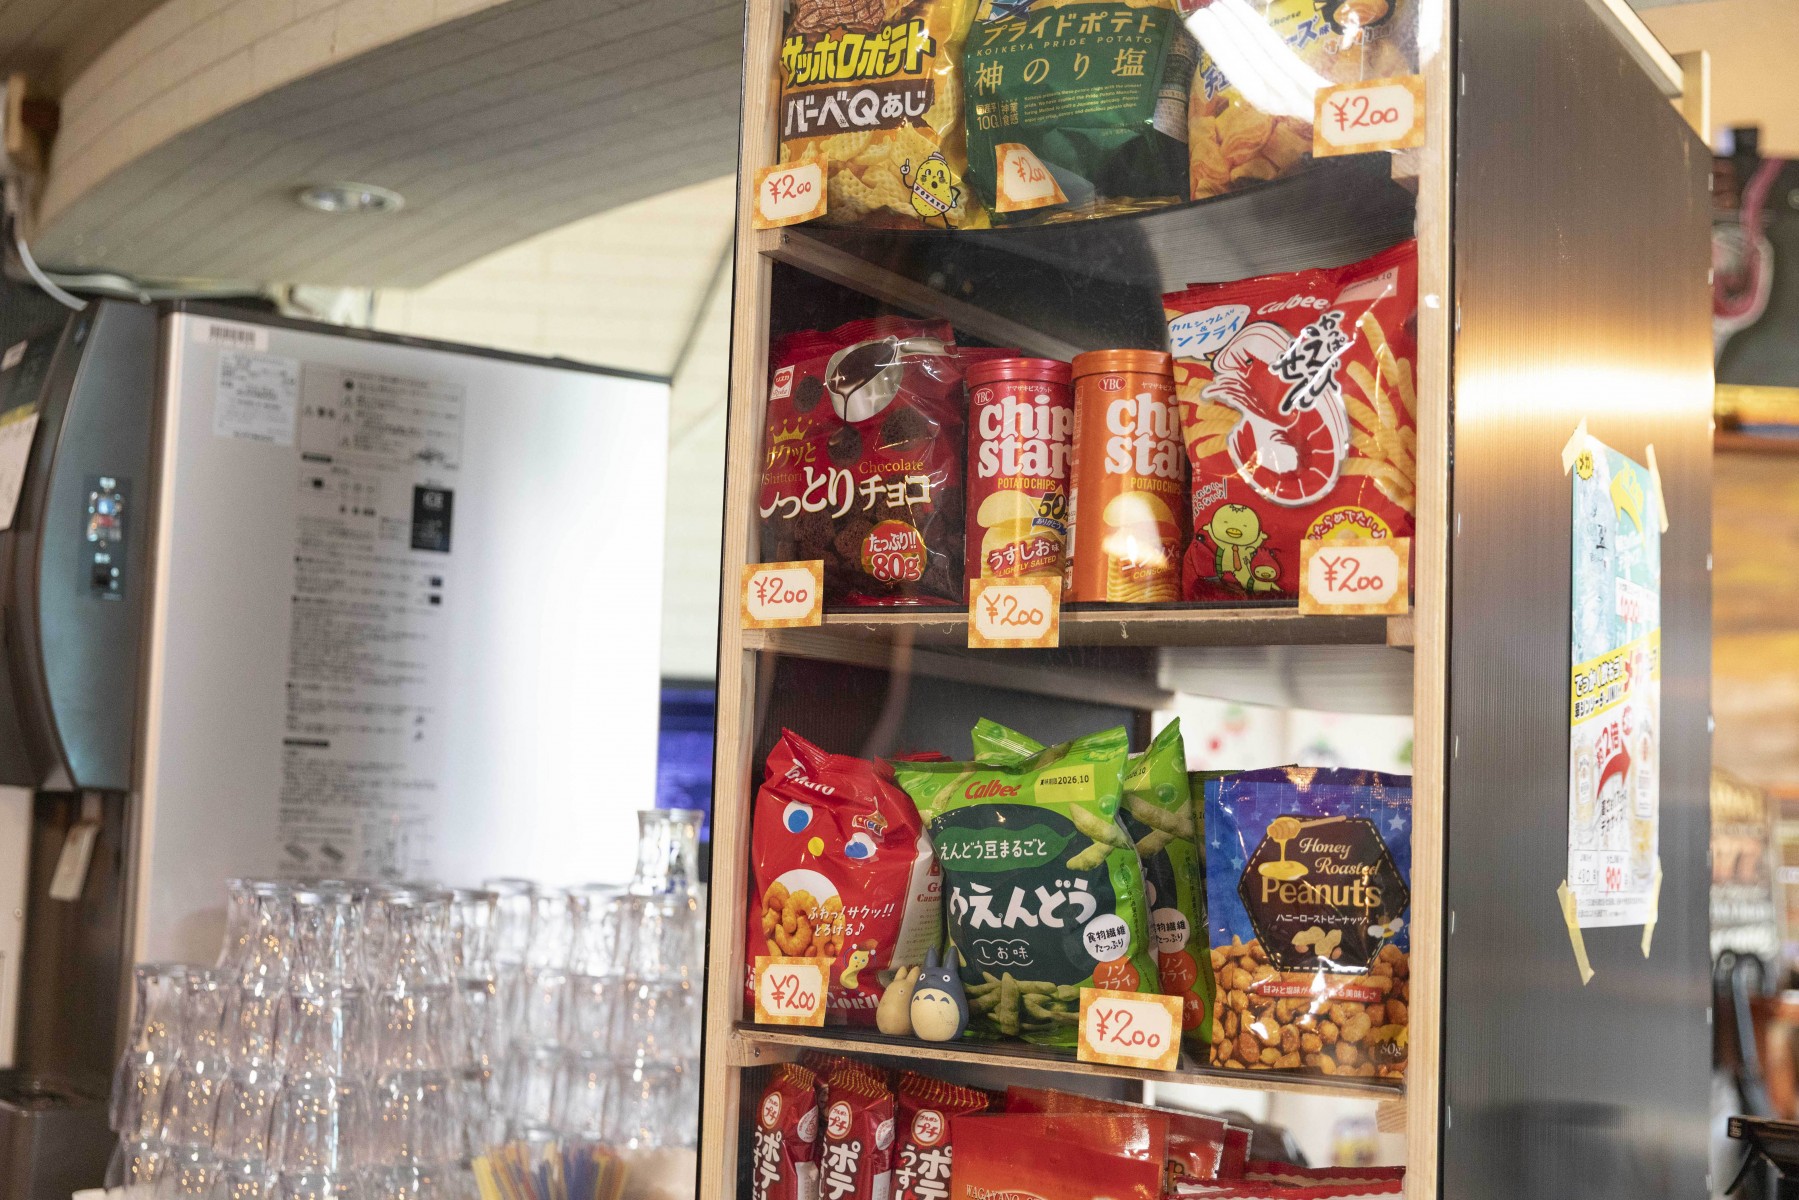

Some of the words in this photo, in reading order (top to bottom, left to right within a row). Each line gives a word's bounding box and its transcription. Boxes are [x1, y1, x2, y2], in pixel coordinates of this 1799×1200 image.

[983, 11, 1156, 46] プライドポテト
[782, 18, 935, 88] サッポロポテト
[977, 43, 1034, 57] KOIKEYA
[1044, 38, 1086, 49] PRIDE
[1097, 35, 1152, 45] POTATO
[974, 47, 1147, 97] 神のり塩
[784, 89, 927, 136] バーベQあじ
[1329, 96, 1399, 131] ¥200
[769, 174, 812, 205] ¥200
[915, 185, 946, 211] POTATO
[1257, 294, 1331, 315] Calbee
[1169, 316, 1240, 348] ンフライ
[1103, 378, 1123, 390] YBC
[1141, 381, 1175, 393] ヤマザキビス
[976, 390, 991, 404] YBC
[979, 394, 1074, 442] chip
[859, 459, 925, 475] Chocolate
[978, 434, 1073, 479] star
[1104, 432, 1185, 482] sta
[859, 474, 932, 512] チョコ
[997, 477, 1030, 490] POTATO
[1030, 478, 1056, 491] CHIPS
[1130, 477, 1161, 490] POTATO
[990, 540, 1060, 571] うすしお味
[999, 562, 1029, 577] LIGHTLY
[1030, 555, 1057, 568] SALTED
[871, 553, 922, 582] 80g
[1133, 562, 1176, 580] CONSOE
[1319, 555, 1383, 592] ¥200
[754, 576, 808, 607] ¥200
[983, 593, 1044, 626] ¥200
[964, 779, 1023, 800] Calbee
[1040, 774, 1090, 786] 2026.10
[940, 838, 1048, 861] えんどう豆まるごと
[1299, 837, 1352, 860] Honey
[1315, 856, 1382, 876] Roasted
[1261, 876, 1382, 908] Peanuts
[950, 877, 1098, 930] やえんどう
[814, 923, 853, 937] とろける
[1276, 913, 1369, 926] ハニーローストピーナッツ
[1086, 924, 1127, 943] 食物繊維
[981, 946, 1029, 960] しお味
[1095, 938, 1125, 954] たっぷり
[1107, 963, 1126, 976] ノン
[770, 974, 816, 1011] ¥200
[1096, 1009, 1161, 1048] ¥200
[1380, 1042, 1402, 1056] 80g
[765, 1107, 778, 1121] プチ
[828, 1116, 848, 1132] プチ
[917, 1122, 940, 1137] プチ
